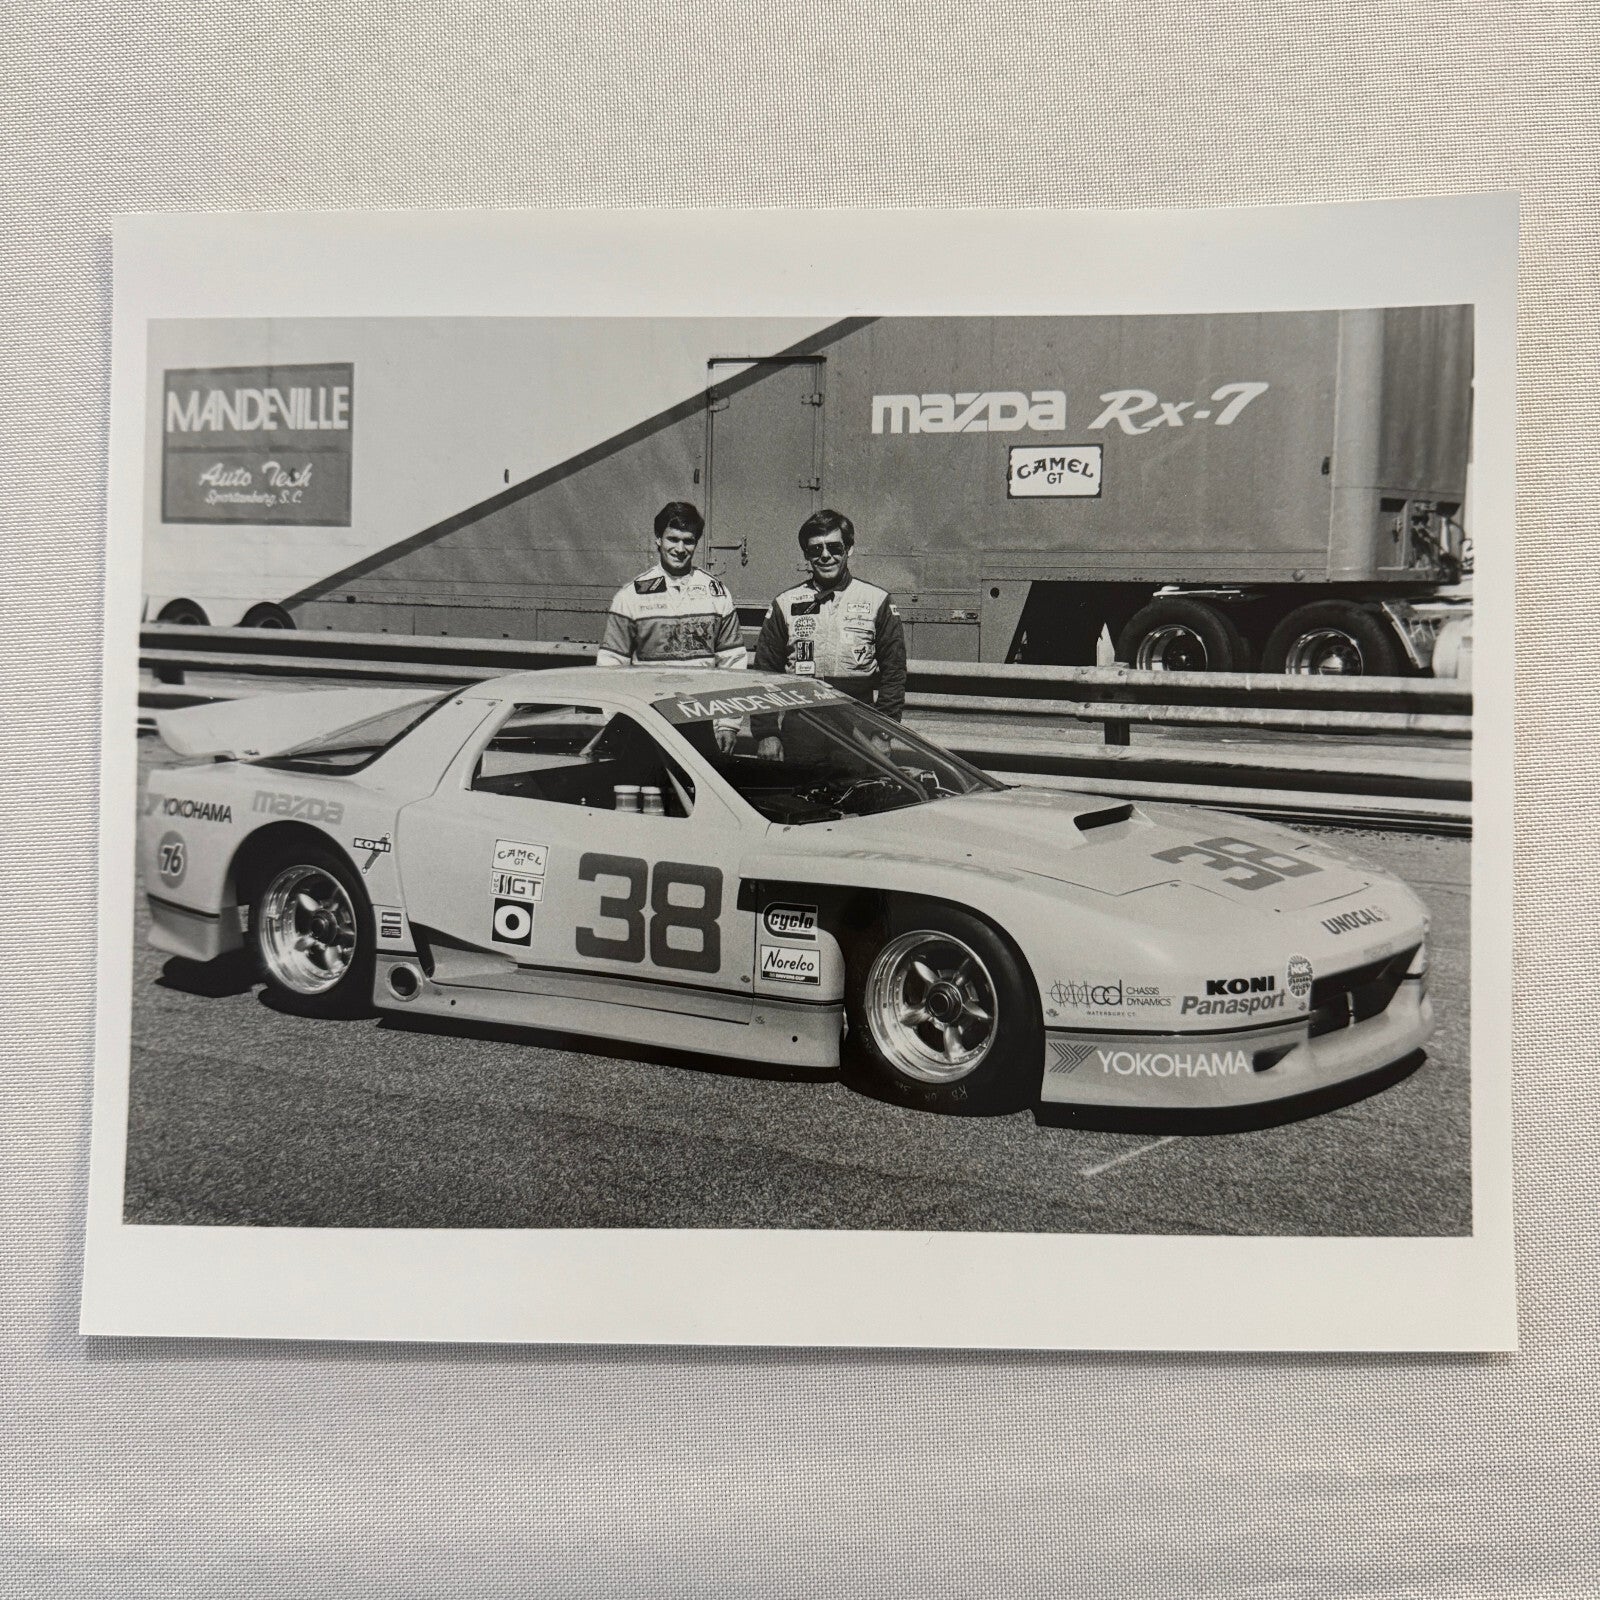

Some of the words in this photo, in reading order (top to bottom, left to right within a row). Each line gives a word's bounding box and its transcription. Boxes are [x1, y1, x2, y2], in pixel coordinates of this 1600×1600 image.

[166, 386, 349, 433] MANDEVILLE
[199, 462, 252, 487] Auto
[262, 461, 313, 488] Tech
[1016, 457, 1095, 480] CAMEL
[1046, 472, 1063, 485] GT
[676, 690, 814, 719] MANDEVILLE
[162, 798, 232, 824] YOKOHAMA
[354, 838, 391, 852] KONI
[161, 842, 186, 876] 76
[497, 849, 542, 866] CAMEL
[514, 858, 524, 866] GT
[1151, 836, 1325, 891] 38
[512, 877, 541, 897] GT
[575, 852, 724, 974] 38
[770, 912, 815, 931] cyclo
[1320, 908, 1383, 935] UNOCAL
[763, 949, 815, 972] Norelco
[1126, 986, 1160, 996] CHASSIS
[1206, 976, 1275, 996] KONI
[1126, 997, 1172, 1007] DYNAMICS
[1181, 988, 1286, 1016] Panasport
[1097, 1050, 1250, 1078] YOKOHAMA
